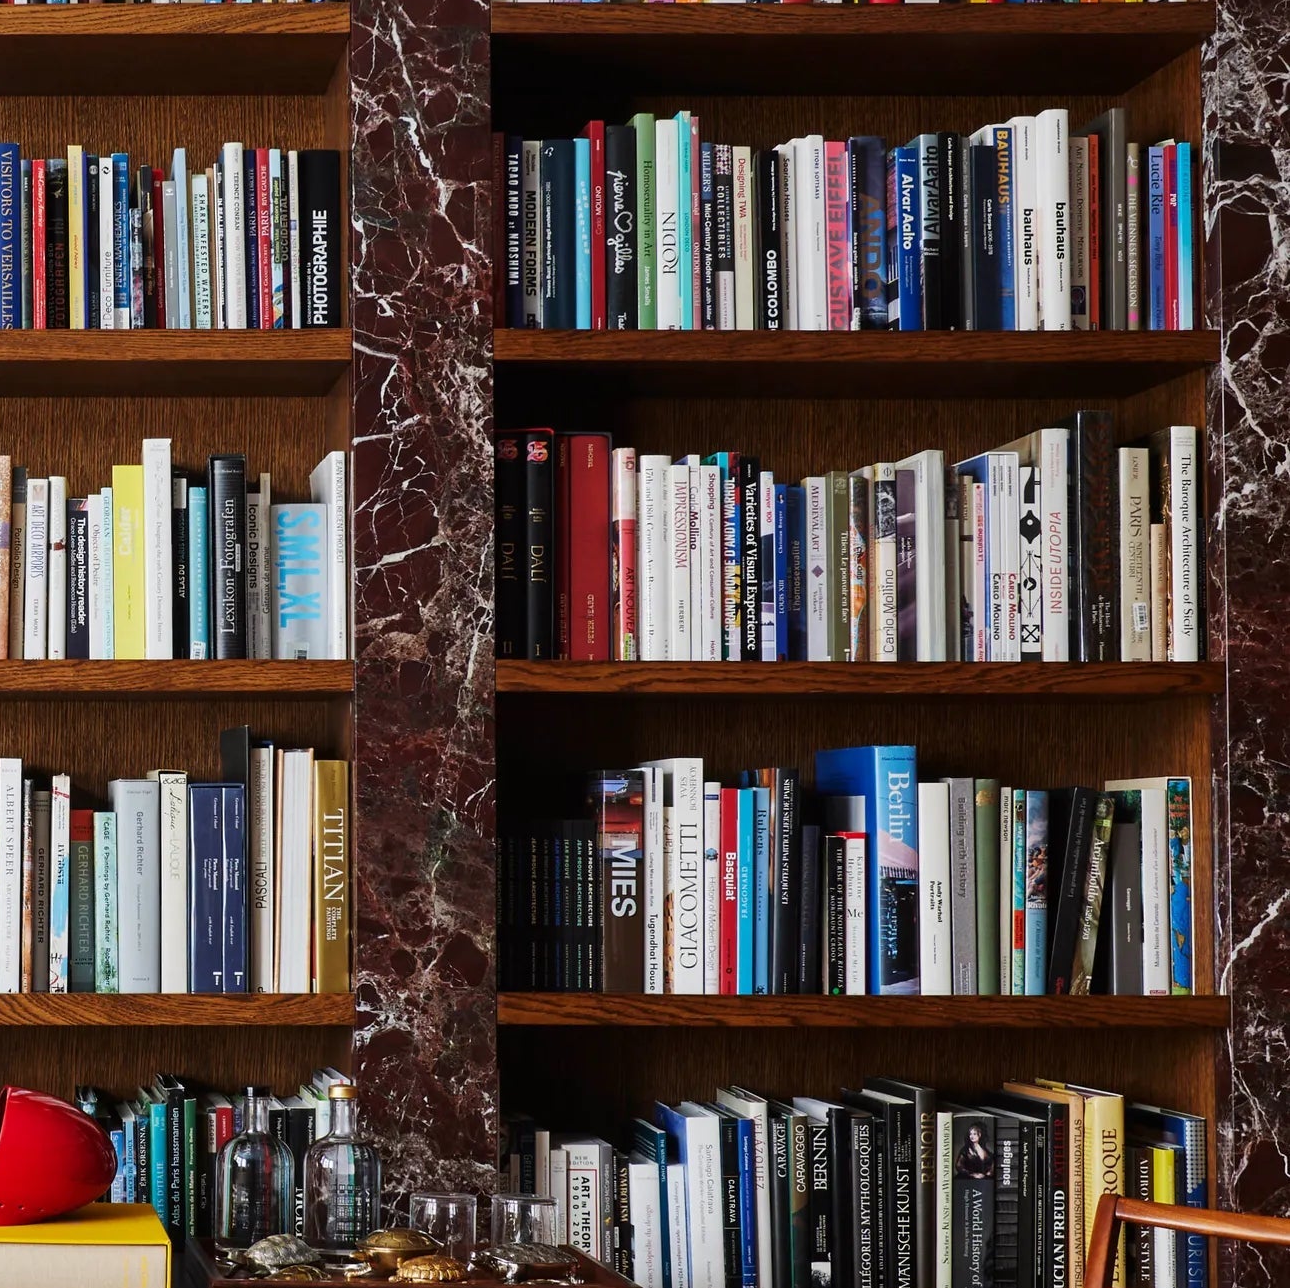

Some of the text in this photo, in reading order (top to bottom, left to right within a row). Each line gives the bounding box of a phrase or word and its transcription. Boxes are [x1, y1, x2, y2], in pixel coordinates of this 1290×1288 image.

[901, 174, 915, 250] Alvar Aalto
[1150, 155, 1162, 214] Lucie Rie
[199, 193, 209, 316] SHARK INFESTED WATERS
[311, 210, 327, 325] PHOTOGRAPHIE
[525, 191, 537, 296] MODERN FORMS
[661, 212, 679, 275] RODIN
[1024, 209, 1034, 265] bauhaus
[1056, 202, 1067, 260] bauhaus
[274, 511, 321, 628] S,M,L,XL
[745, 482, 758, 651] Varieties of Visual Experience
[1179, 454, 1193, 637] The Baroque Architecture of Sicily
[888, 771, 910, 842] Berlin
[323, 808, 344, 900] TITIAN
[611, 840, 636, 917] MIES
[724, 852, 736, 900] Basquiat
[1087, 838, 1104, 902] Arcimboldo
[78, 846, 89, 953] GERHARD RICHTER
[679, 823, 698, 969] GIACOMETTI
[649, 914, 659, 990] Tugendhat House
[814, 1128, 828, 1191] BERNIN
[1002, 1141, 1011, 1185] soulages
[728, 1179, 737, 1223] CALATRAVA
